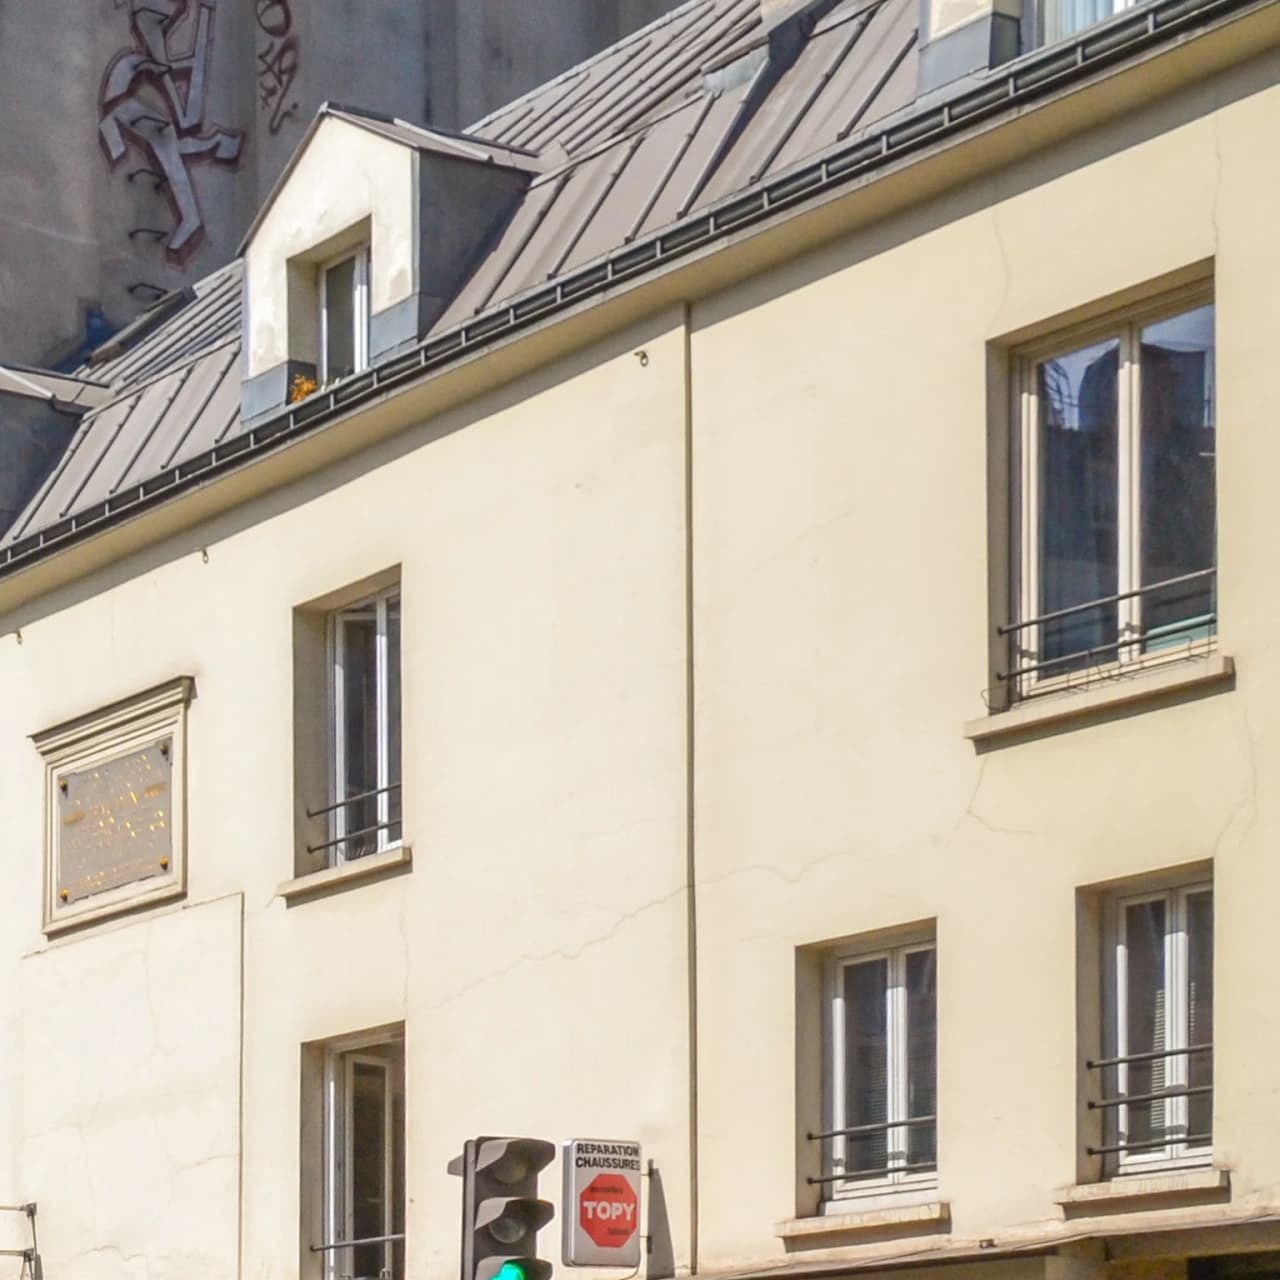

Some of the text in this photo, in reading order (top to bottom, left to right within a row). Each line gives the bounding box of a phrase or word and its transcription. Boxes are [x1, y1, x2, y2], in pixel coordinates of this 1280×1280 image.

[576, 1143, 639, 1157] REPARATION
[575, 1157, 640, 1171] CHAUSSURES
[583, 1201, 635, 1221] TOPY
